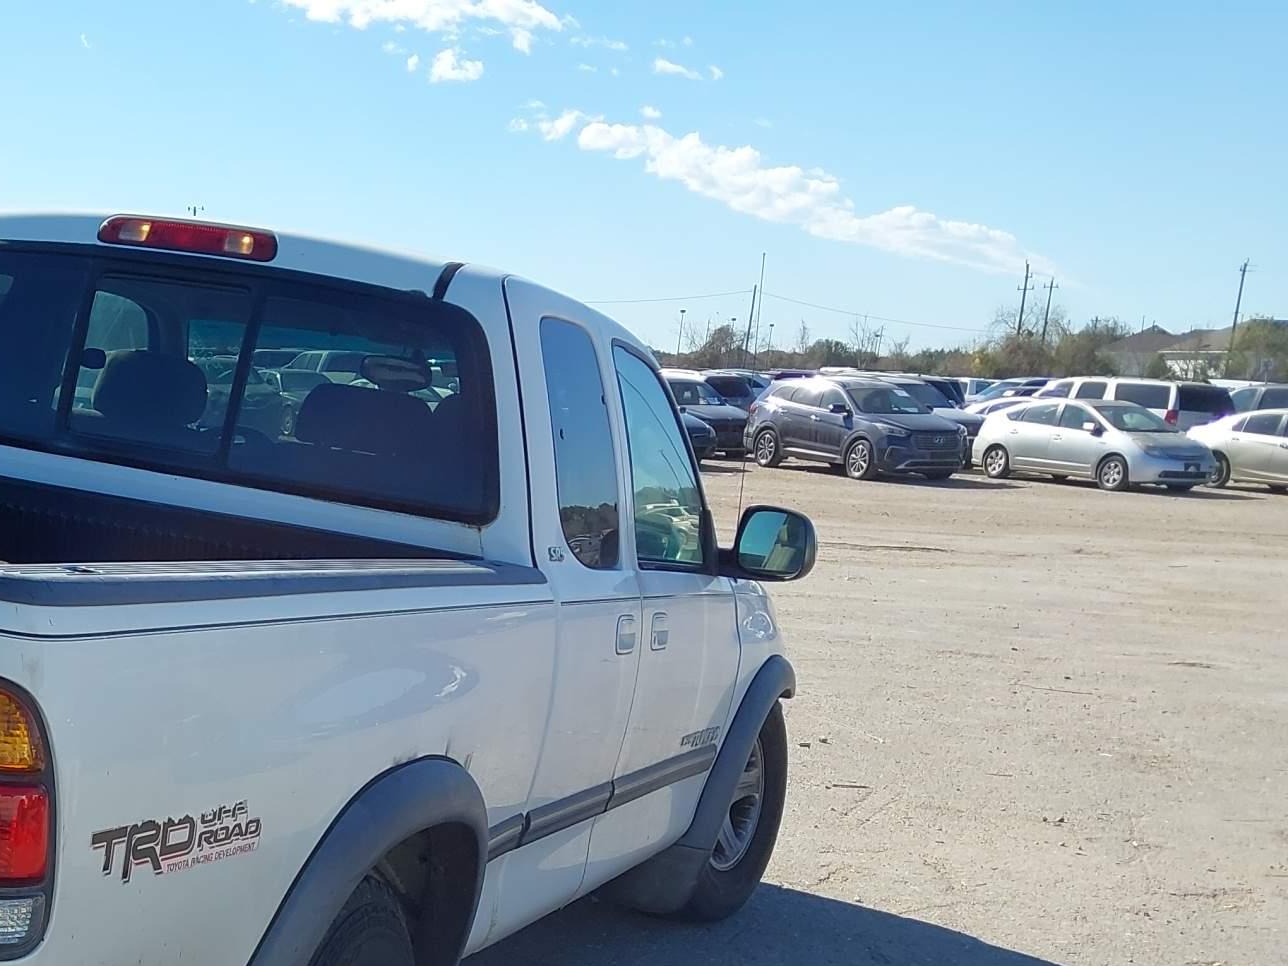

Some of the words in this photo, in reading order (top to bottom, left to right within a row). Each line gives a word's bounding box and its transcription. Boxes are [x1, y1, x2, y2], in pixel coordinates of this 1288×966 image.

[200, 800, 249, 826] OFF
[90, 814, 196, 884] TRD
[197, 818, 262, 850] ROAD
[166, 857, 190, 873] TOYOTA
[190, 851, 214, 869] RACING
[214, 841, 256, 861] DEVELOPMENT
